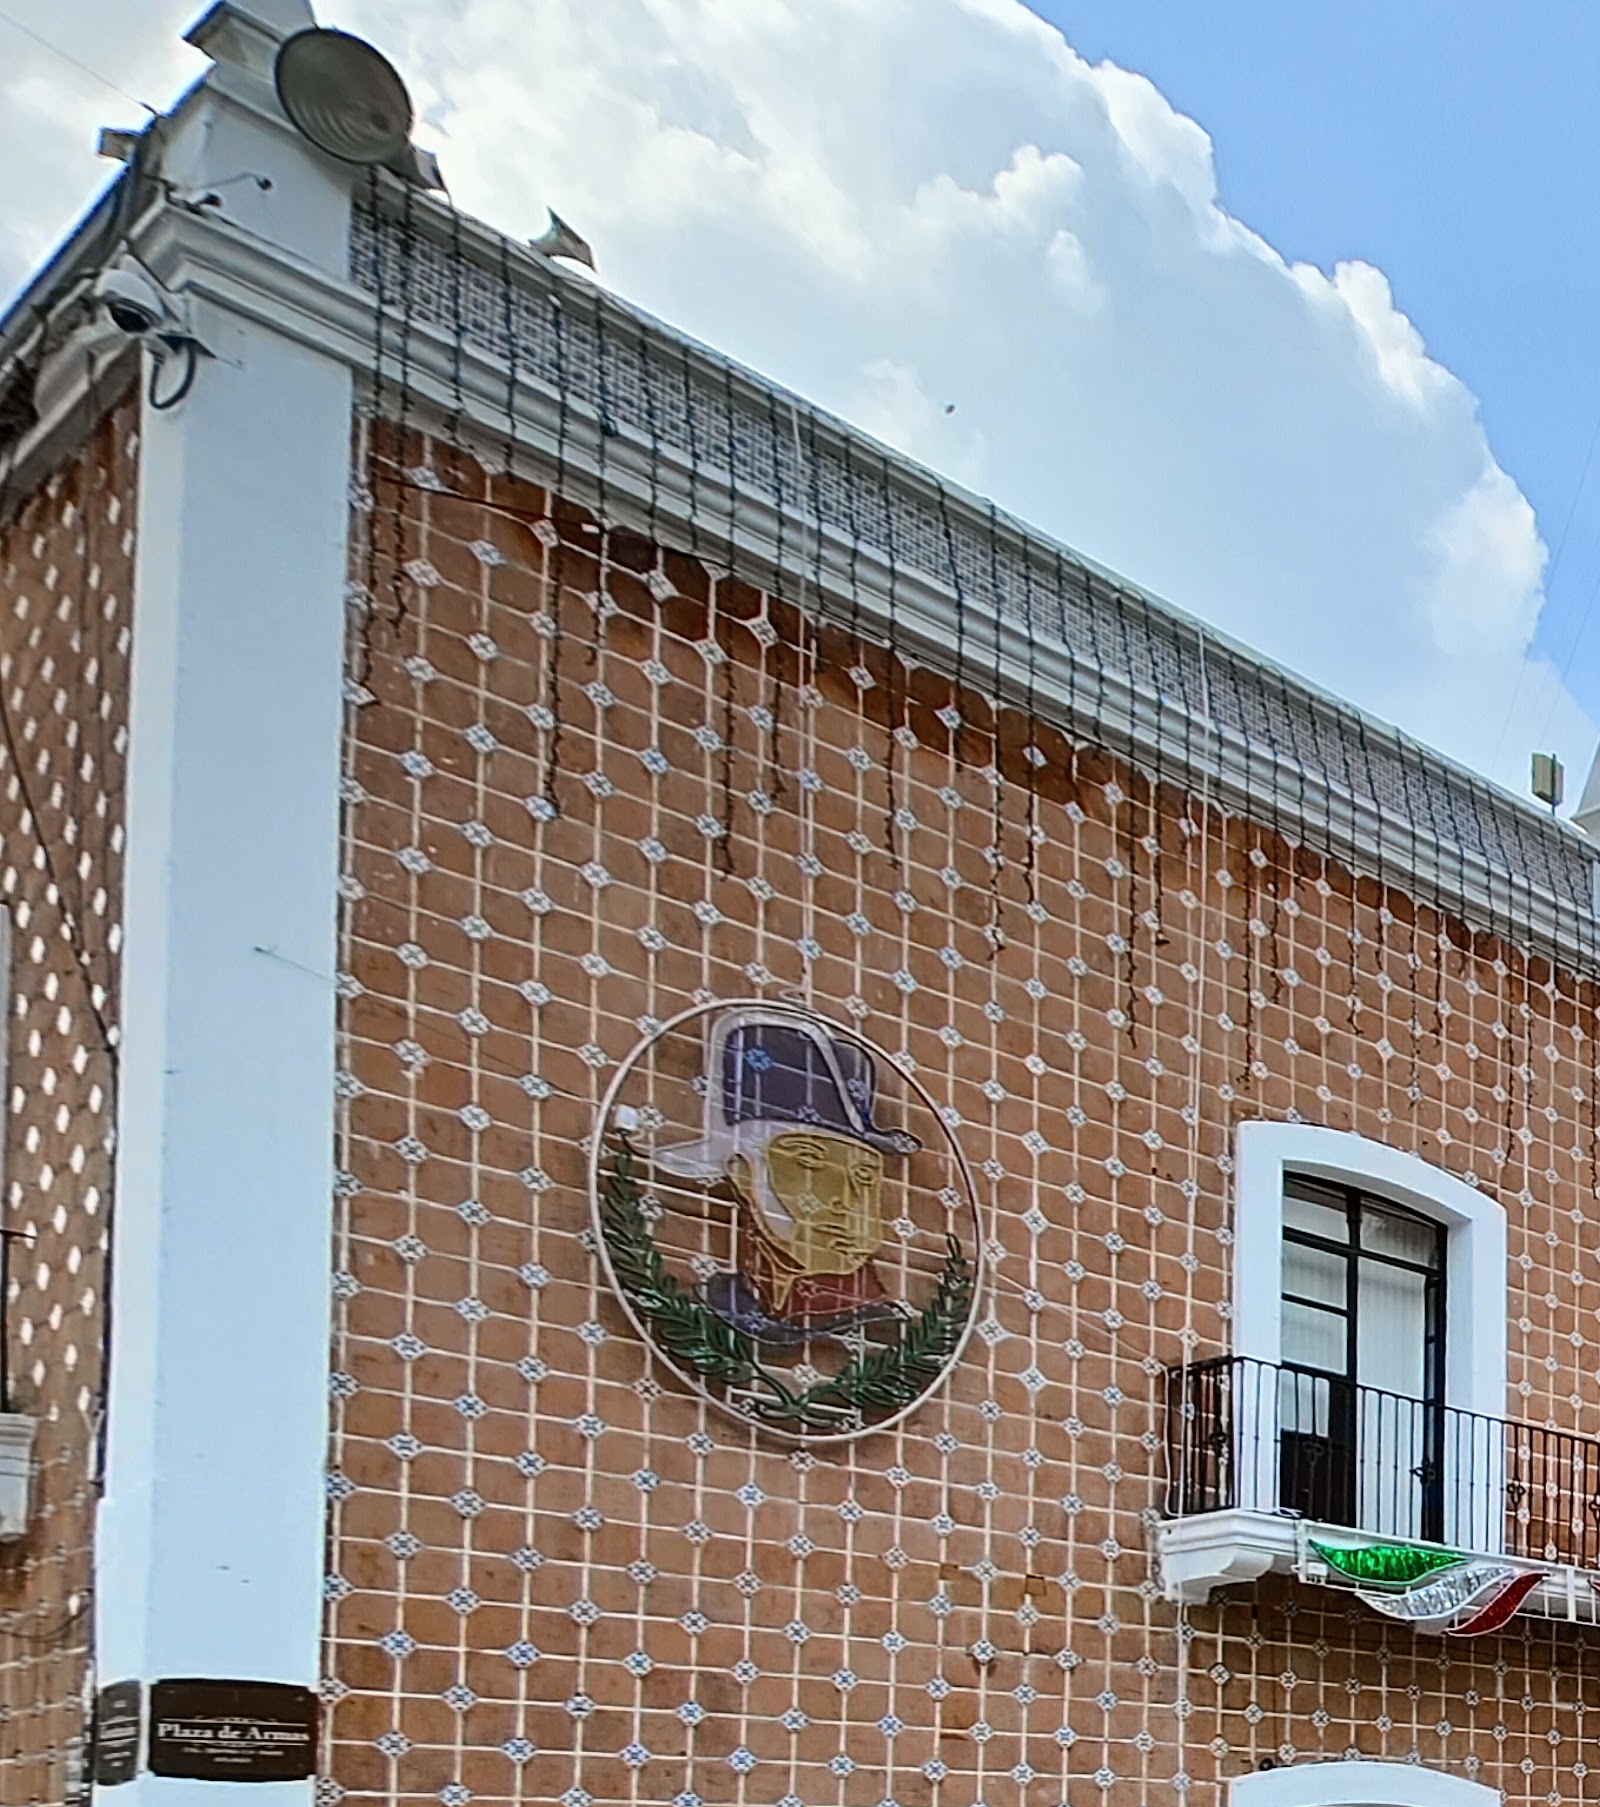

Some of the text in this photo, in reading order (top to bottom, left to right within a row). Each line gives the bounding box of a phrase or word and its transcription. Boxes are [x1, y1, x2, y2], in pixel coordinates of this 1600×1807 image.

[157, 1723, 310, 1741] Plaza de Armas
